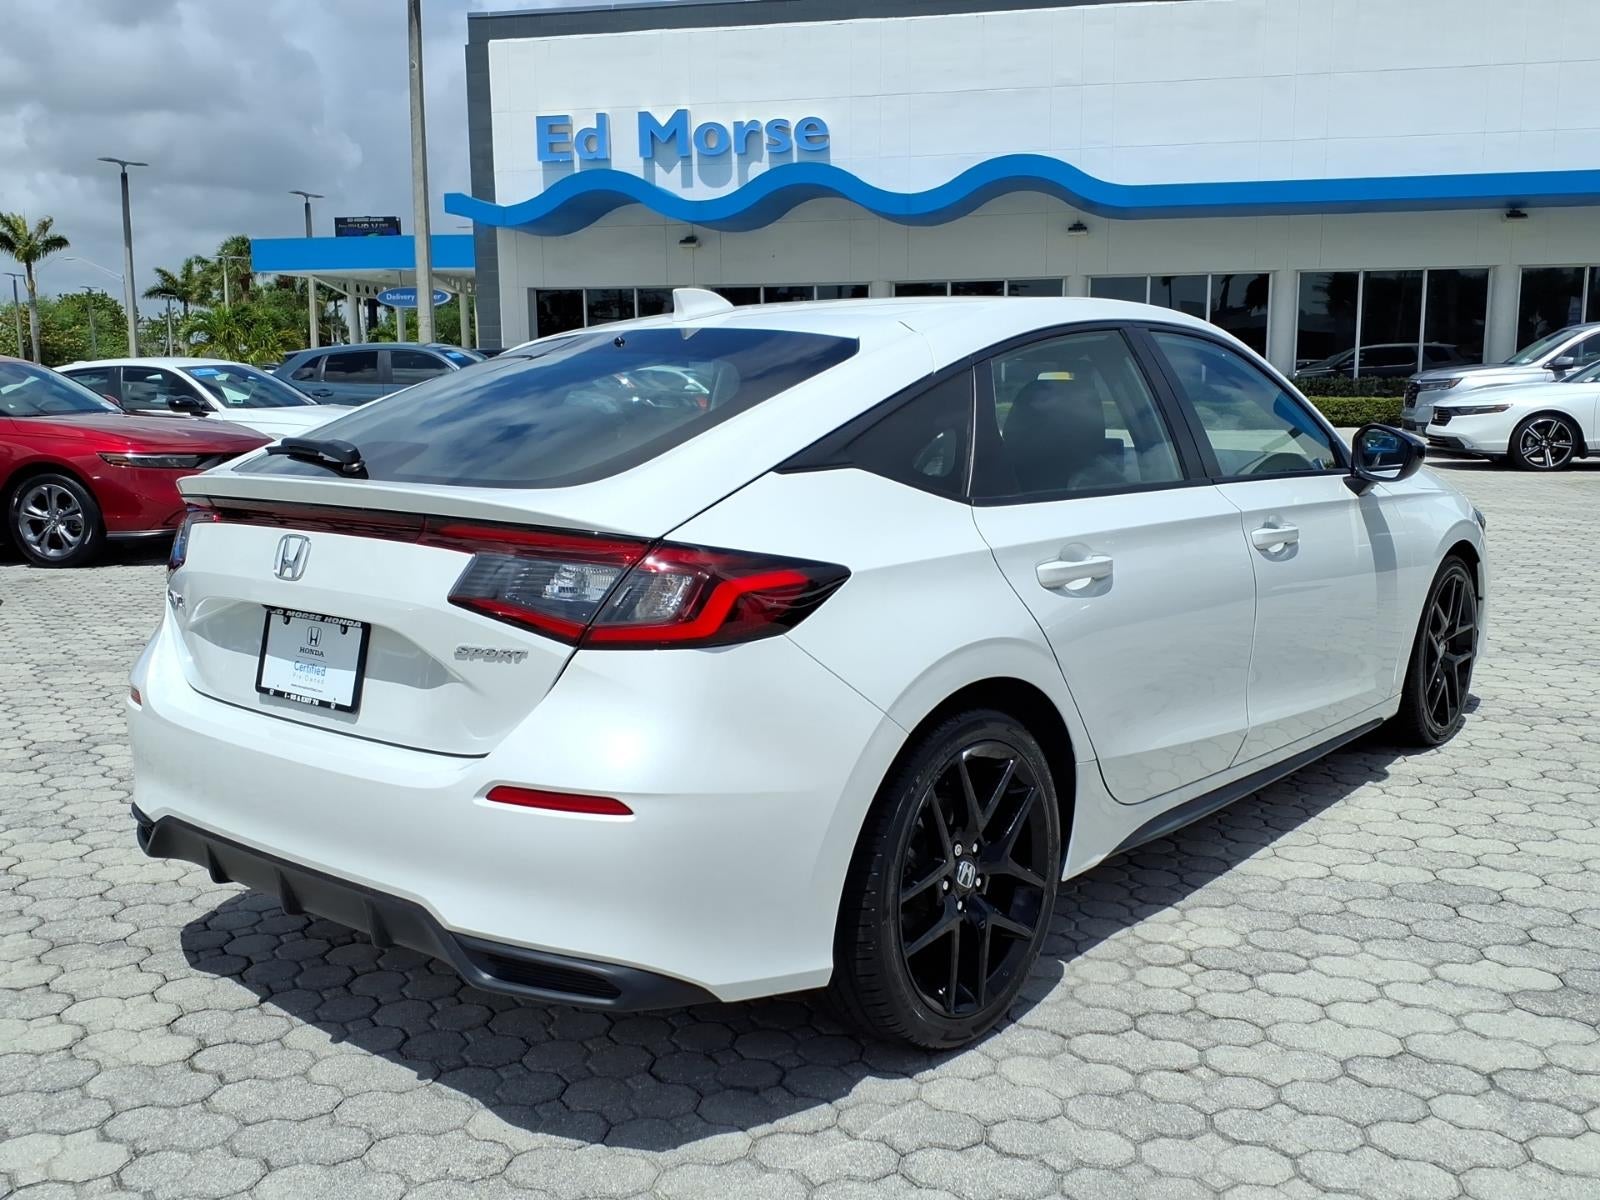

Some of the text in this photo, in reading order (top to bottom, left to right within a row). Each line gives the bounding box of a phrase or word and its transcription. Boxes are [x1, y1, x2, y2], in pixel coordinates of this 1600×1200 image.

[536, 108, 830, 162] Ed Morse
[386, 293, 415, 302] Delivery
[286, 610, 323, 621] MORSE
[324, 616, 362, 628] HONDA
[299, 646, 325, 657] HONDA
[455, 645, 529, 663] SPORT
[294, 660, 327, 677] Certified
